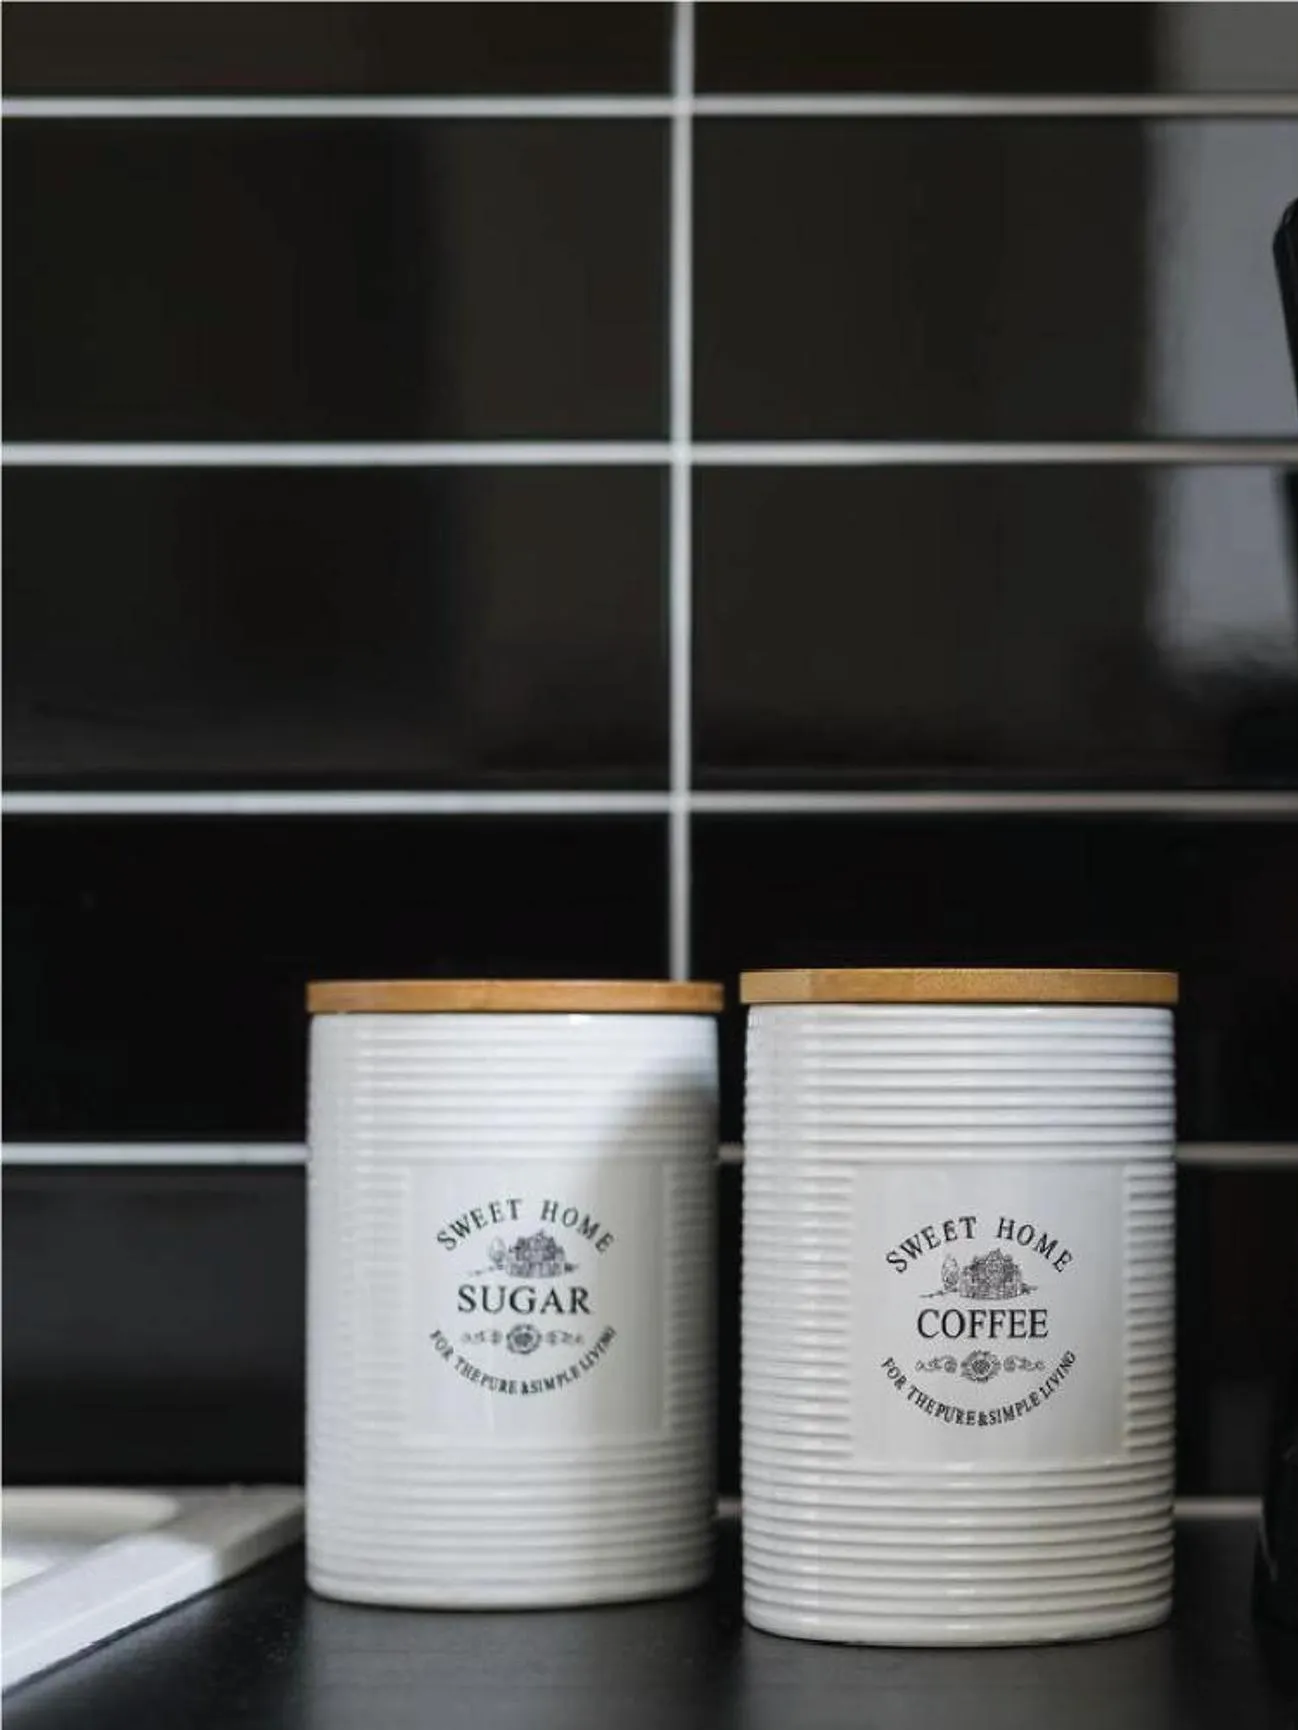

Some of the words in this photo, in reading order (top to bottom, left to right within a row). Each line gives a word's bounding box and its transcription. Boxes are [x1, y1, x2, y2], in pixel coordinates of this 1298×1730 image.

[436, 1198, 522, 1251] SWEET
[540, 1199, 615, 1254] HOME
[885, 1216, 977, 1273] SWEET
[996, 1216, 1073, 1273] HOME
[457, 1284, 591, 1314] SUGAR
[917, 1308, 1049, 1339] COFFEE
[880, 1356, 908, 1391] FOR
[1038, 1349, 1077, 1399] LIVING
